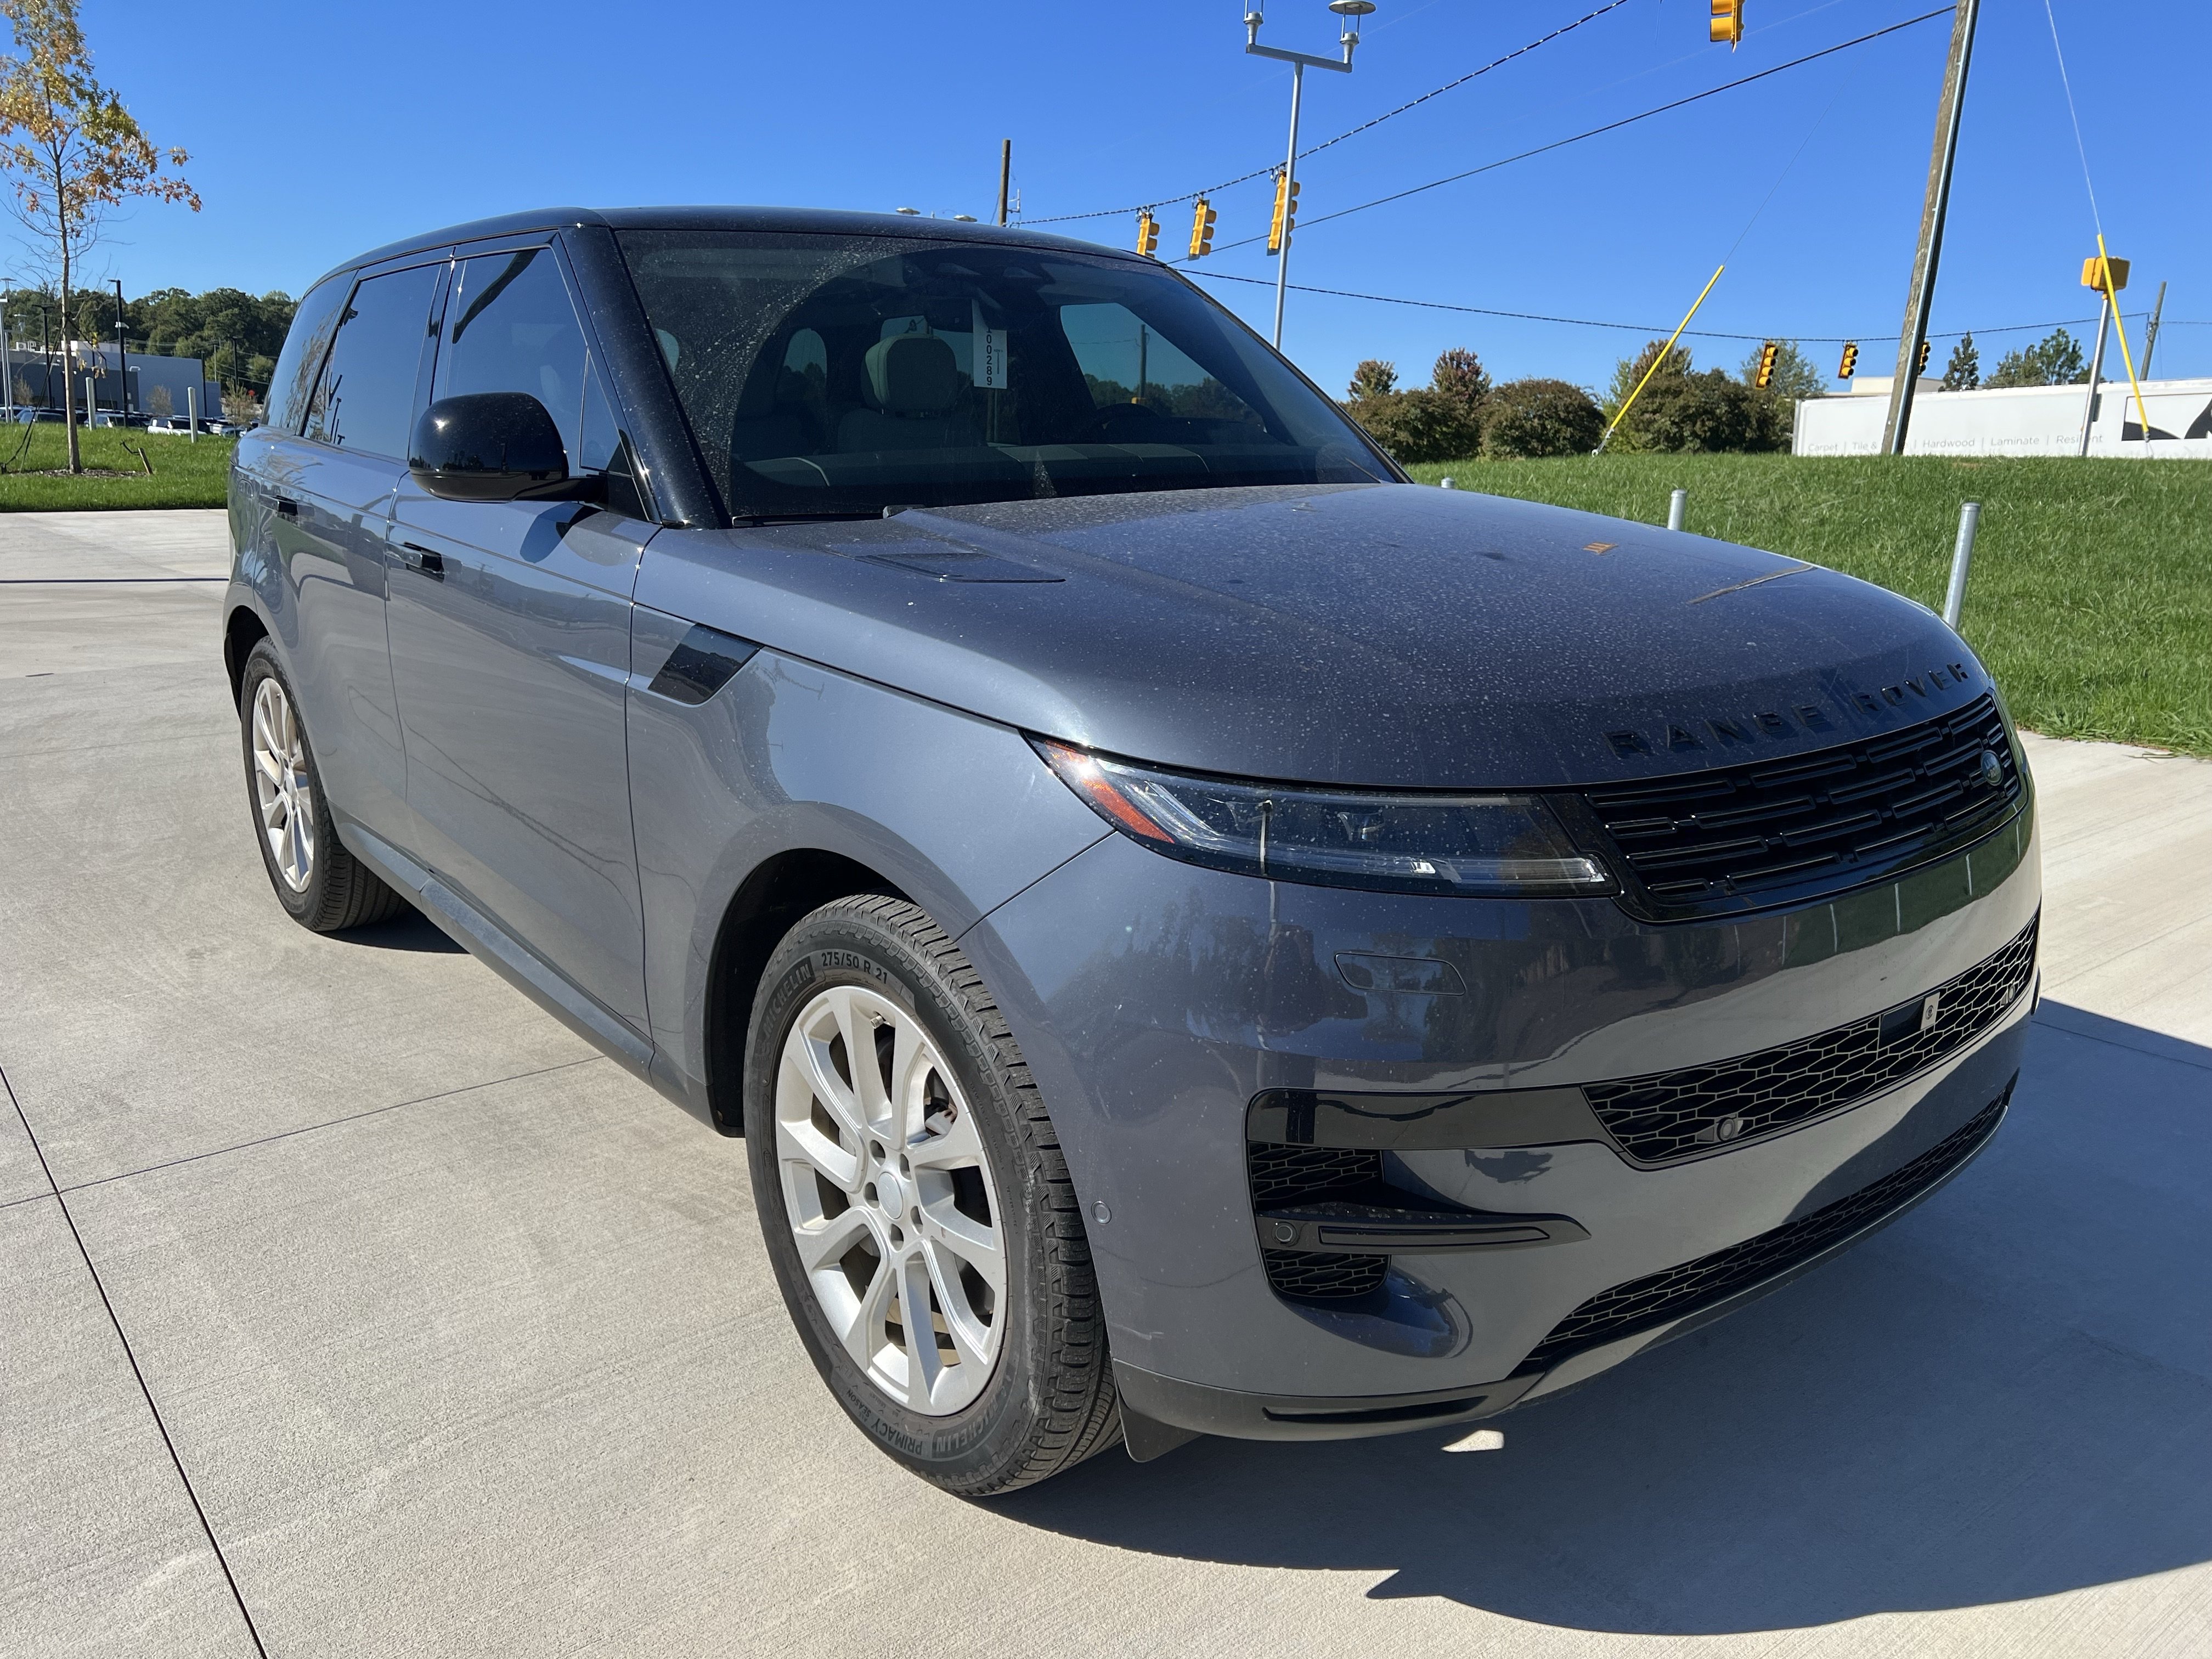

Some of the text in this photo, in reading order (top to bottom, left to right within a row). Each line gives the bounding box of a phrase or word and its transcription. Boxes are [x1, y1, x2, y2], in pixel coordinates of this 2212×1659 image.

[1808, 443, 1838, 452] Carpet
[1853, 442, 1866, 450] Tile
[1922, 438, 1975, 448] Hardwood
[1991, 437, 2040, 446] Laminate
[2056, 434, 2103, 444] Resint
[1601, 663, 1968, 760] RANGE ROVER
[821, 951, 860, 969] 275/50
[864, 960, 871, 974] R
[876, 967, 888, 984] 21
[764, 963, 812, 1039] MICHELIN
[846, 1390, 872, 1418] SEASON
[871, 1418, 923, 1455] PRIMACY
[936, 1394, 998, 1452] MICHELIN
